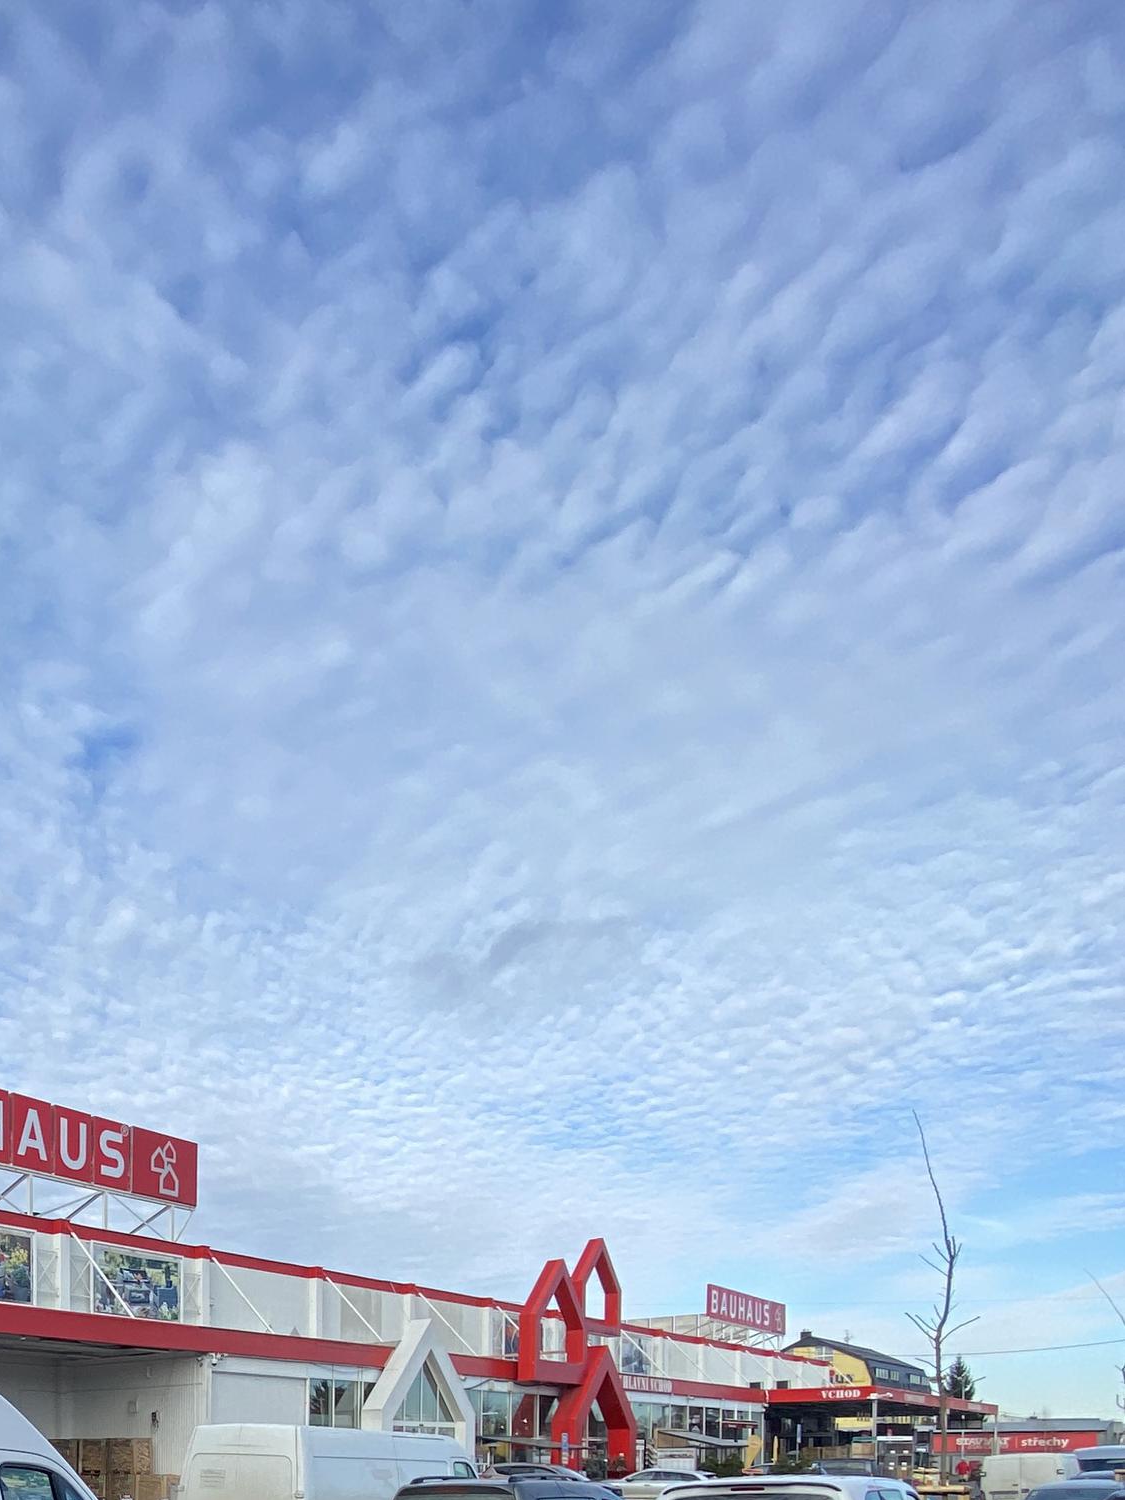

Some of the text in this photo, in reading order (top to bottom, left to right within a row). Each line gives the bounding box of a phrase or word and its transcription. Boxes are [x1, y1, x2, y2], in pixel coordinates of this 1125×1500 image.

[711, 1290, 770, 1327] BAUHAUS
[821, 1389, 861, 1399] VCHOD
[1021, 1436, 1070, 1448] střechy
